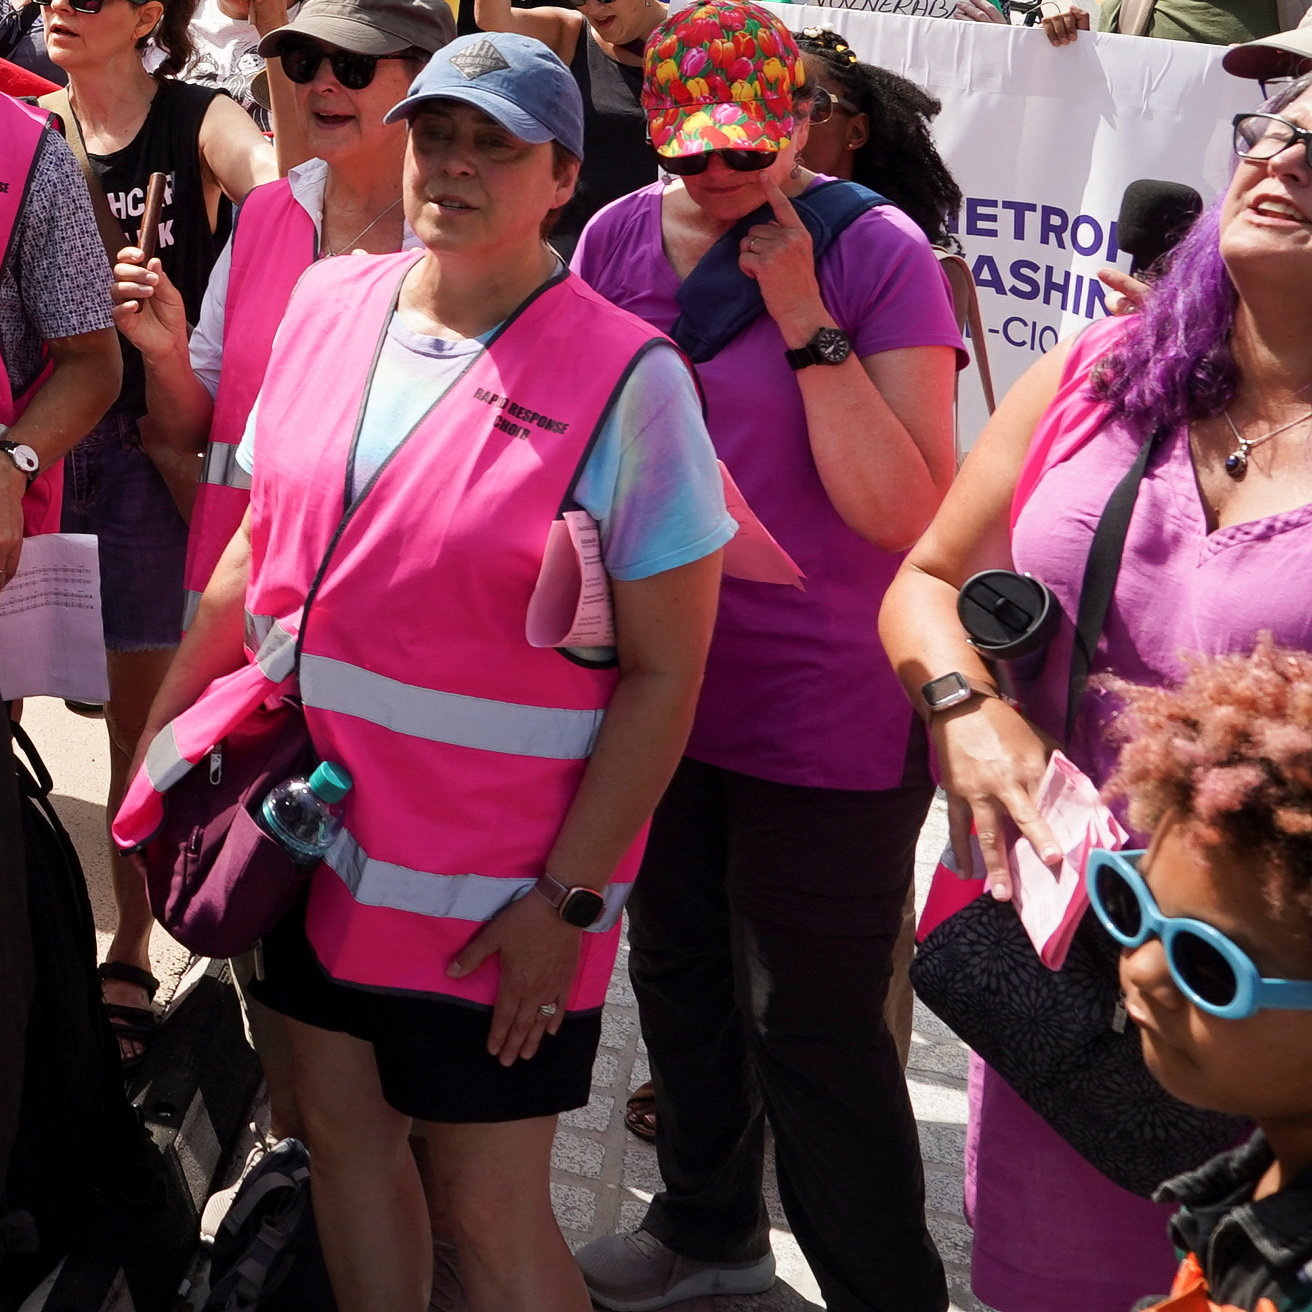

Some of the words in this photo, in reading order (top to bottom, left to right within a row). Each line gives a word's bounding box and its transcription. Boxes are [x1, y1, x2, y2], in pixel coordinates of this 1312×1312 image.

[473, 387, 508, 410] RAPID
[508, 401, 570, 434] RESPONSE
[493, 415, 531, 441] CHOIR
